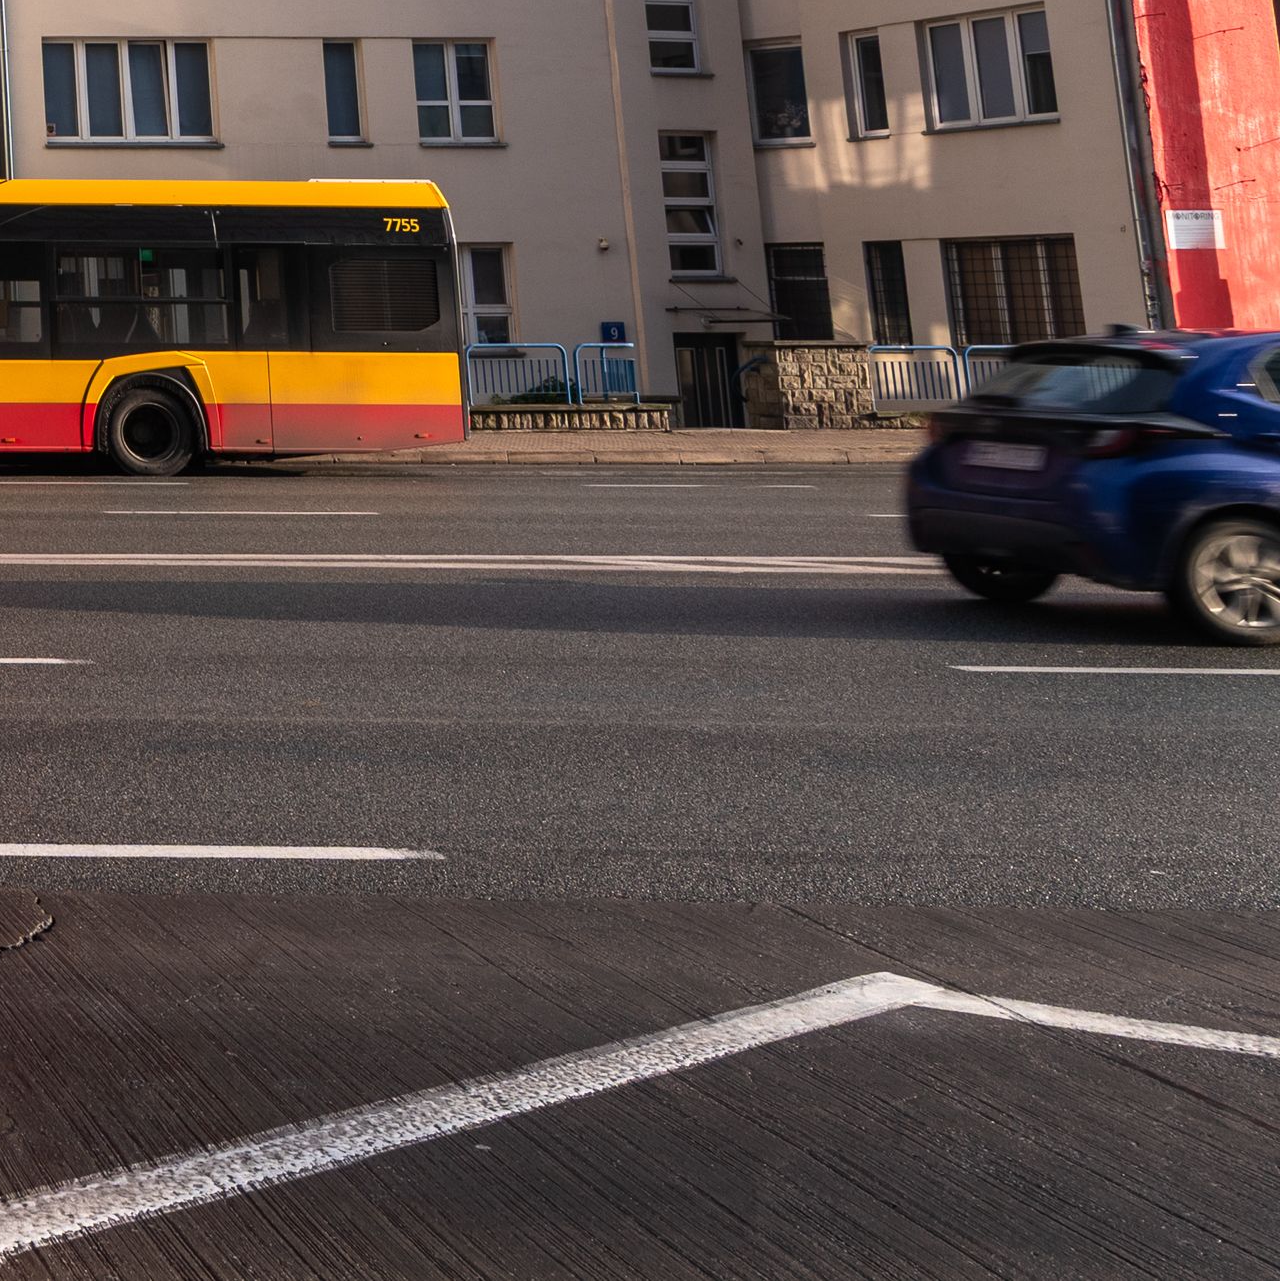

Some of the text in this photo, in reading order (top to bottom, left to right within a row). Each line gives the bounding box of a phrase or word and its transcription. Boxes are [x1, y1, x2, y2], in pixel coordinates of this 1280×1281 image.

[1167, 212, 1220, 221] ONITORING
[383, 218, 420, 233] 7755
[610, 326, 619, 340] 9
